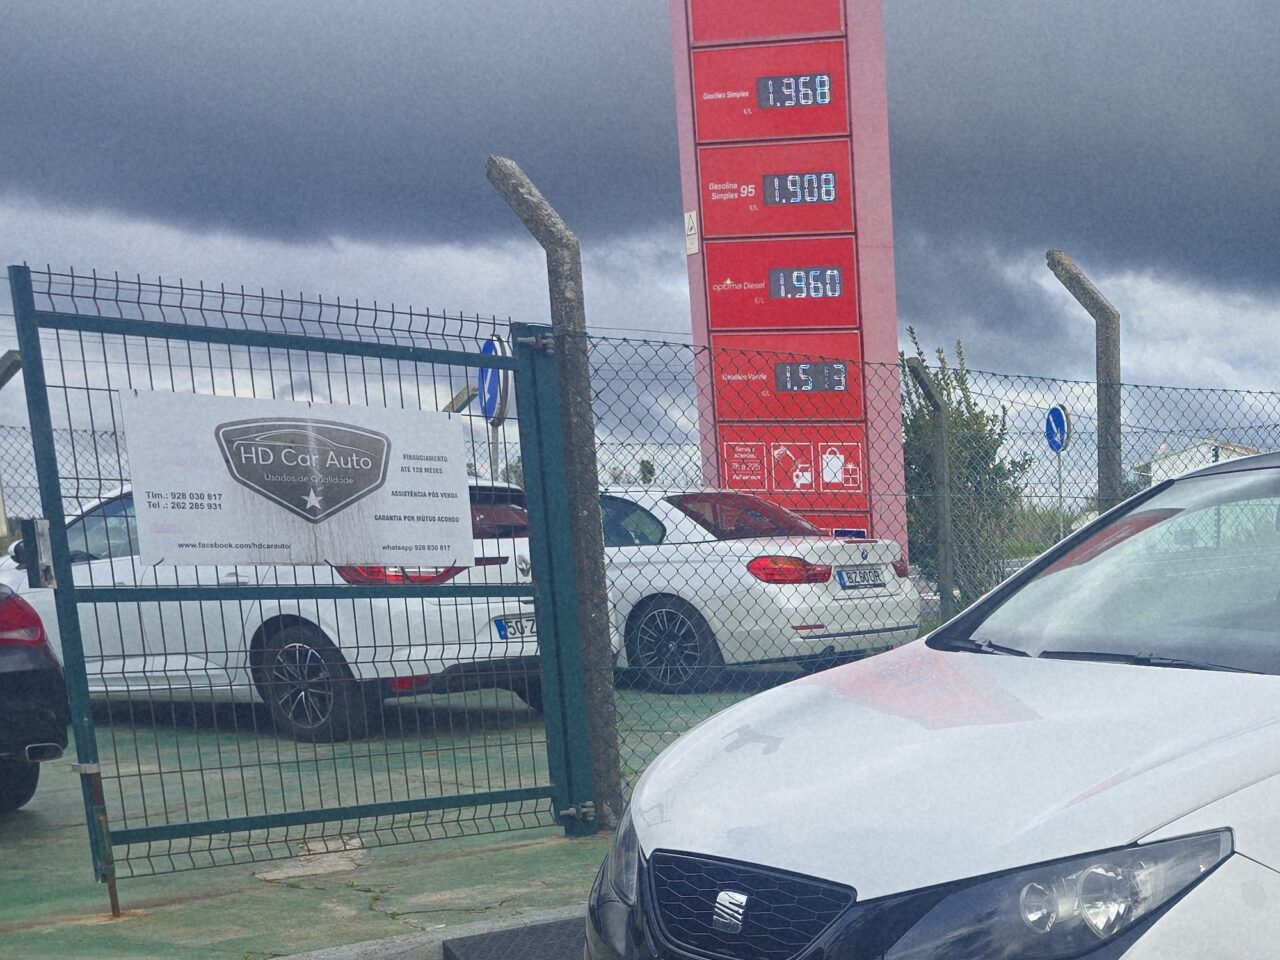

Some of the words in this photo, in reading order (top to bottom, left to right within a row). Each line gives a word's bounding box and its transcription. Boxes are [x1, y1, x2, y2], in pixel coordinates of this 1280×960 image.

[768, 75, 830, 106] 1.968
[709, 182, 738, 190] Gasolina
[774, 173, 836, 203] 1.908
[711, 191, 738, 201] Simples
[740, 184, 756, 197] 95
[743, 281, 766, 290] Diesel
[779, 269, 841, 298] 1.960
[240, 446, 274, 465] HD
[281, 448, 319, 467] Car
[325, 450, 372, 469] Auto
[402, 453, 449, 463] FINANCIAMENTO
[264, 472, 296, 482] Usados
[299, 474, 309, 482] de
[310, 474, 355, 484] Qualidade
[170, 492, 187, 500] 928
[189, 492, 205, 500] 030
[207, 493, 223, 501] 817
[170, 501, 187, 509] 262
[189, 502, 205, 510] 285
[207, 502, 222, 510] 931
[374, 514, 402, 522] GARANTIA
[437, 515, 460, 523] ACORDO
[382, 544, 414, 552] whatsapp
